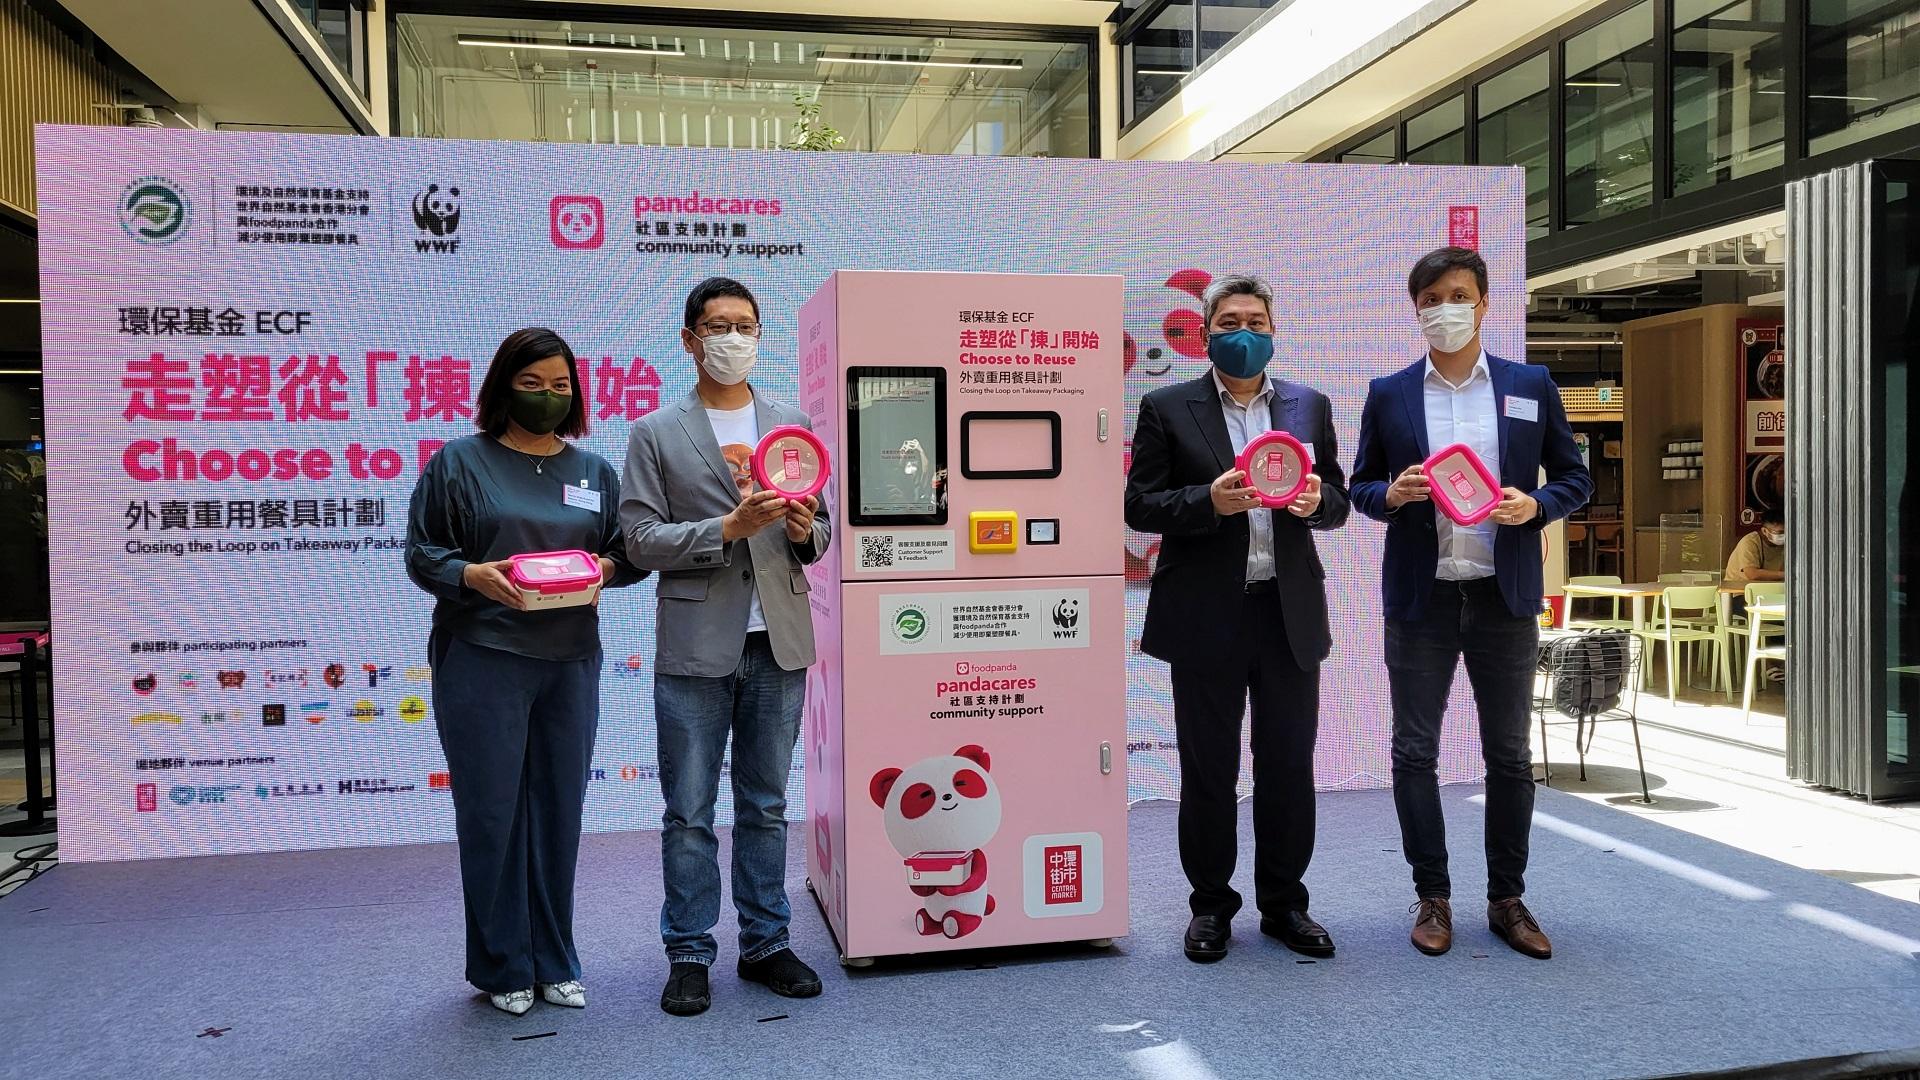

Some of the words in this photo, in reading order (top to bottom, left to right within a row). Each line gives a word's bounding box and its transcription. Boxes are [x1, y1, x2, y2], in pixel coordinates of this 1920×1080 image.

[634, 190, 781, 218] pandacares
[635, 220, 747, 237] 社區支持計劃
[414, 239, 460, 254] WWF
[635, 239, 732, 258] community
[737, 242, 803, 259] support
[118, 306, 246, 336] 環保基金
[255, 310, 312, 335] ECF
[959, 310, 1009, 324] 環保基金
[1012, 312, 1035, 323] ECF
[959, 328, 1100, 350] 走塑從「揀」開始
[959, 352, 1012, 365] Choose
[1015, 354, 1030, 365] to
[1033, 353, 1076, 365] Reuse
[959, 370, 1062, 384] 外賣重用餐具計劃
[122, 351, 663, 423] 走塑從「揀始
[959, 387, 983, 395] Closing
[995, 387, 1011, 395] Loop
[1021, 387, 1052, 395] Takeaway
[1053, 387, 1085, 396] Packaging
[122, 437, 334, 483] Choose
[345, 441, 404, 480] to
[124, 497, 386, 531] 外賣重用餐具計劃
[125, 539, 184, 556] Closing
[188, 539, 214, 552] the
[218, 538, 257, 555] Loop
[262, 541, 281, 551] on
[284, 537, 359, 553] Takeaway
[1053, 630, 1079, 639] WWF
[184, 639, 256, 653] participating
[260, 639, 307, 650] partners
[971, 663, 1017, 673] foodpanda
[937, 676, 1036, 697] pandacares
[950, 694, 1024, 706] 社區支持計劃
[930, 706, 995, 719] community
[998, 705, 1044, 718] support
[189, 759, 224, 767] venue
[227, 756, 275, 768] partners
[1049, 850, 1077, 868] 中環
[1049, 867, 1077, 885] 街市
[1051, 884, 1077, 893] CENTRAL
[1051, 891, 1077, 900] MARKET
